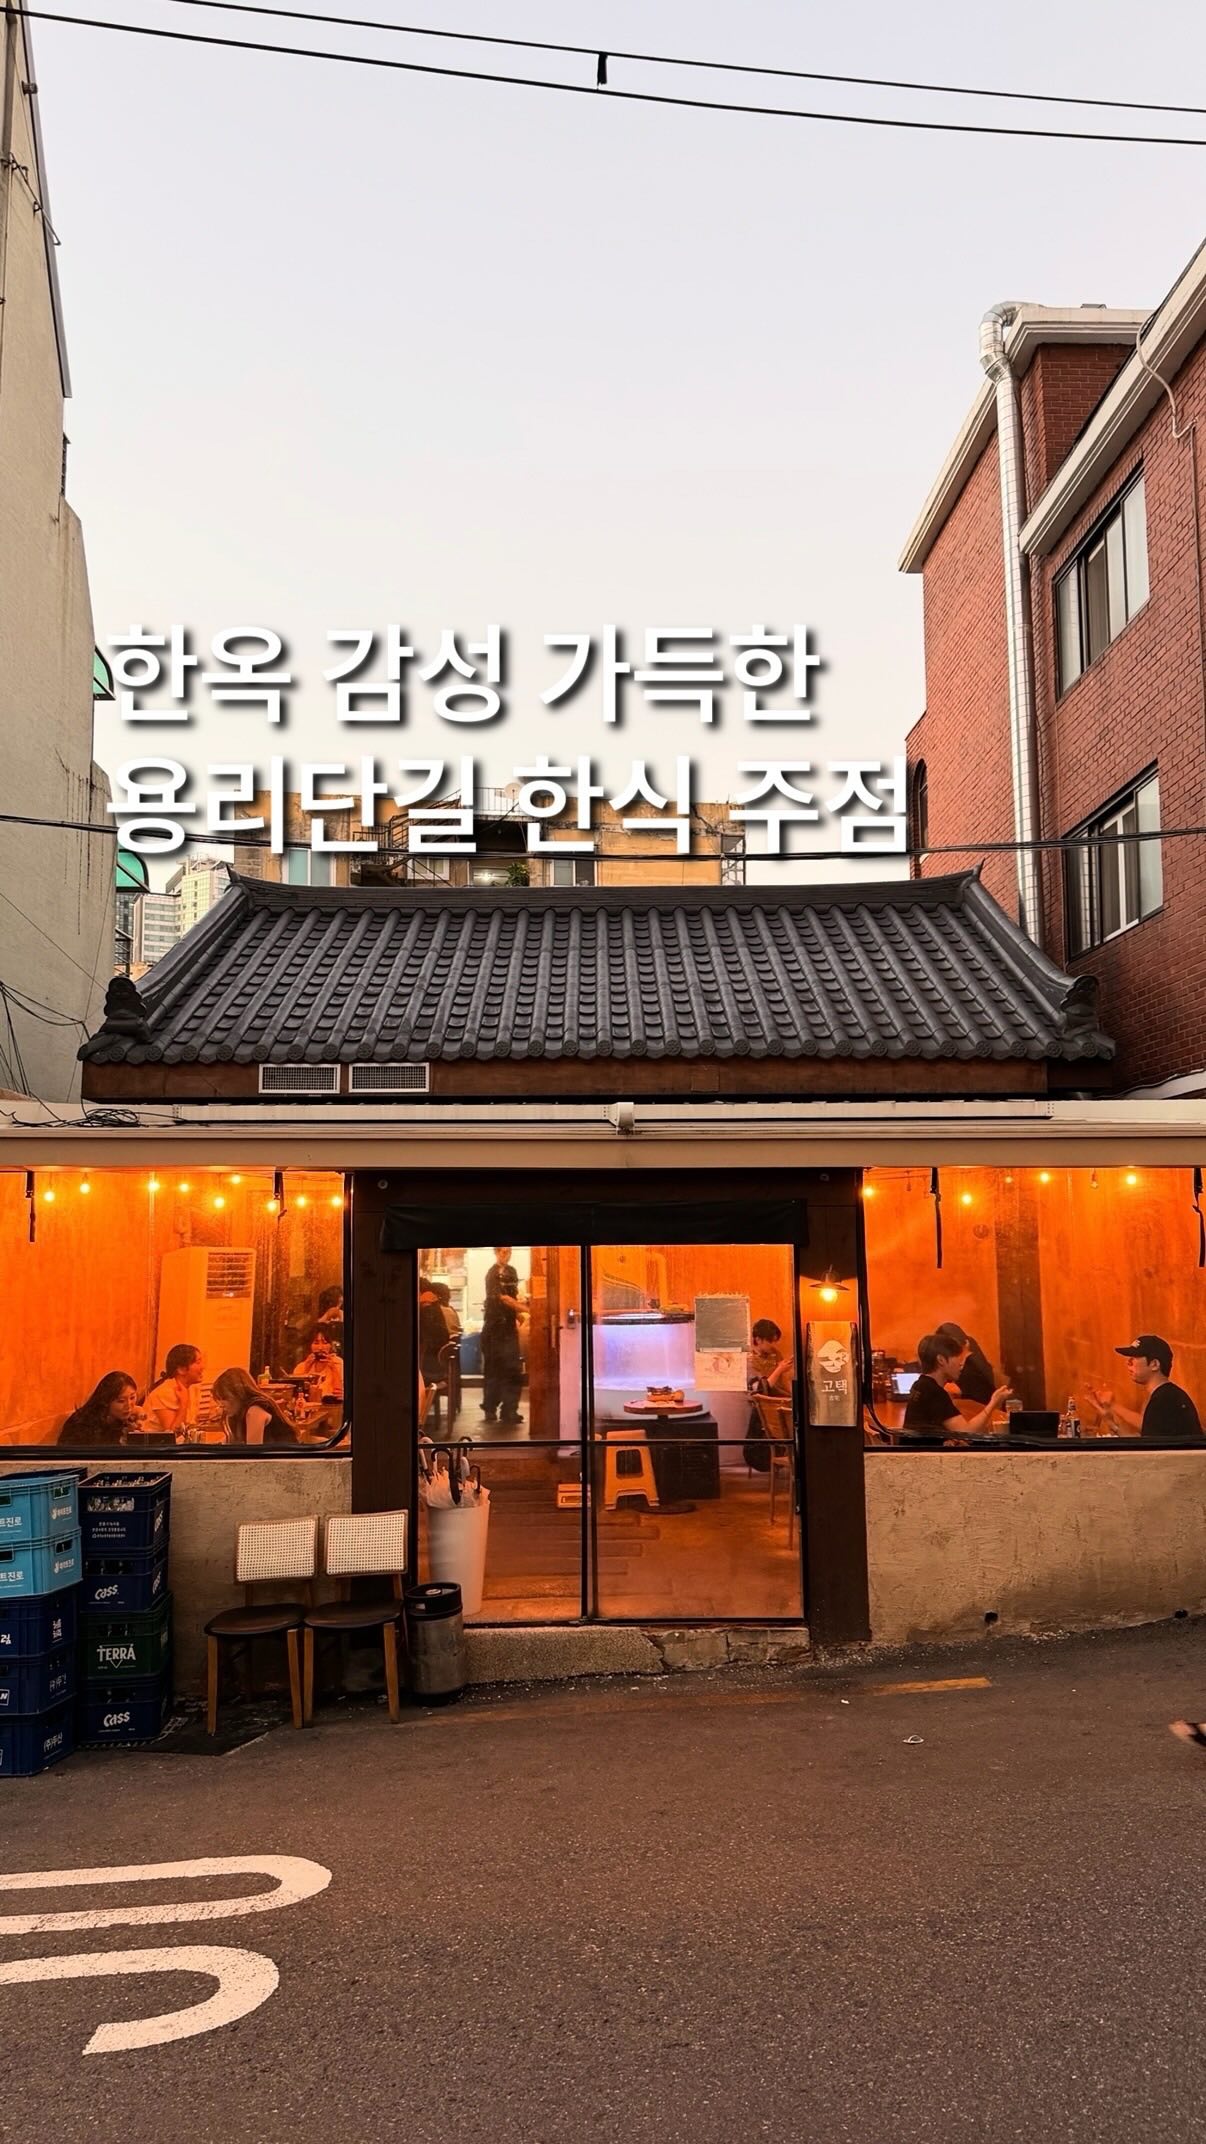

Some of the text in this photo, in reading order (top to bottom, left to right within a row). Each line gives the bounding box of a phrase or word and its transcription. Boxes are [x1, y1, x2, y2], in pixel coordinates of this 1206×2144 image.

[821, 1379, 848, 1395] 고택
[95, 1584, 119, 1600] Cass
[96, 1645, 136, 1662] TERRA
[103, 1711, 130, 1727] Cass
